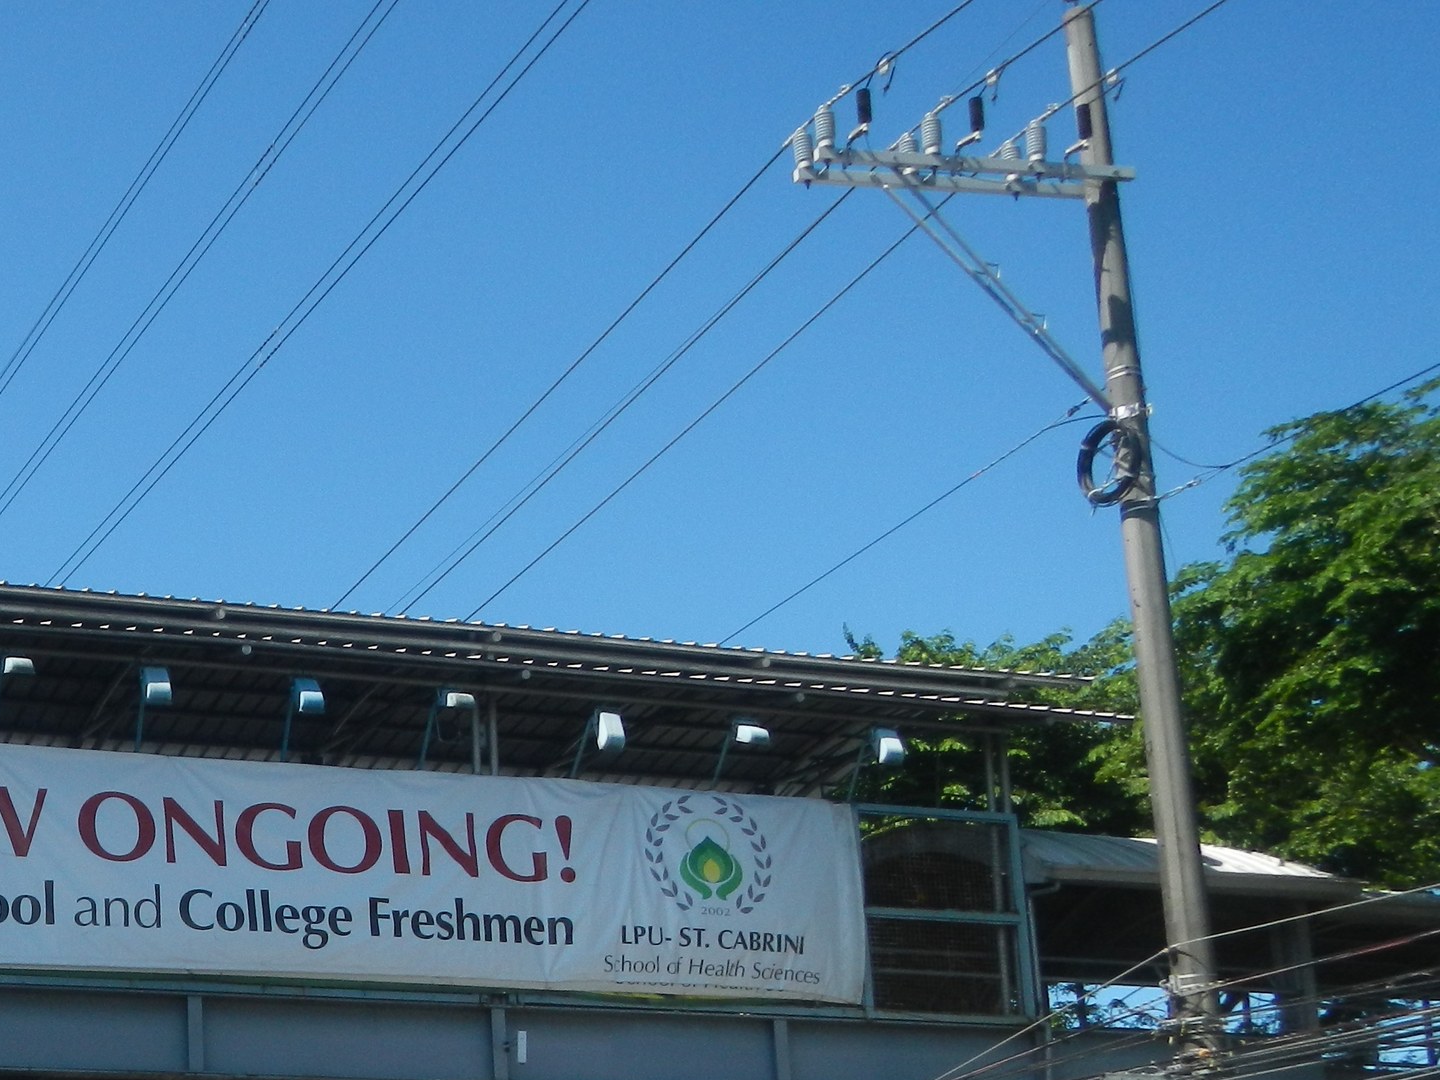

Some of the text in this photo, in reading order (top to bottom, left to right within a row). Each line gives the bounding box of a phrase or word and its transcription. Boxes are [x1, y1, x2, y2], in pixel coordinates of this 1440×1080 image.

[78, 791, 577, 883] ONGOING!
[75, 884, 162, 929] and
[179, 889, 353, 949] College
[369, 898, 574, 946] Freshmen
[701, 906, 731, 917] 2002
[678, 927, 710, 948] ST.
[718, 929, 804, 955] CABRINI
[604, 954, 820, 984] School of Health Sciences
